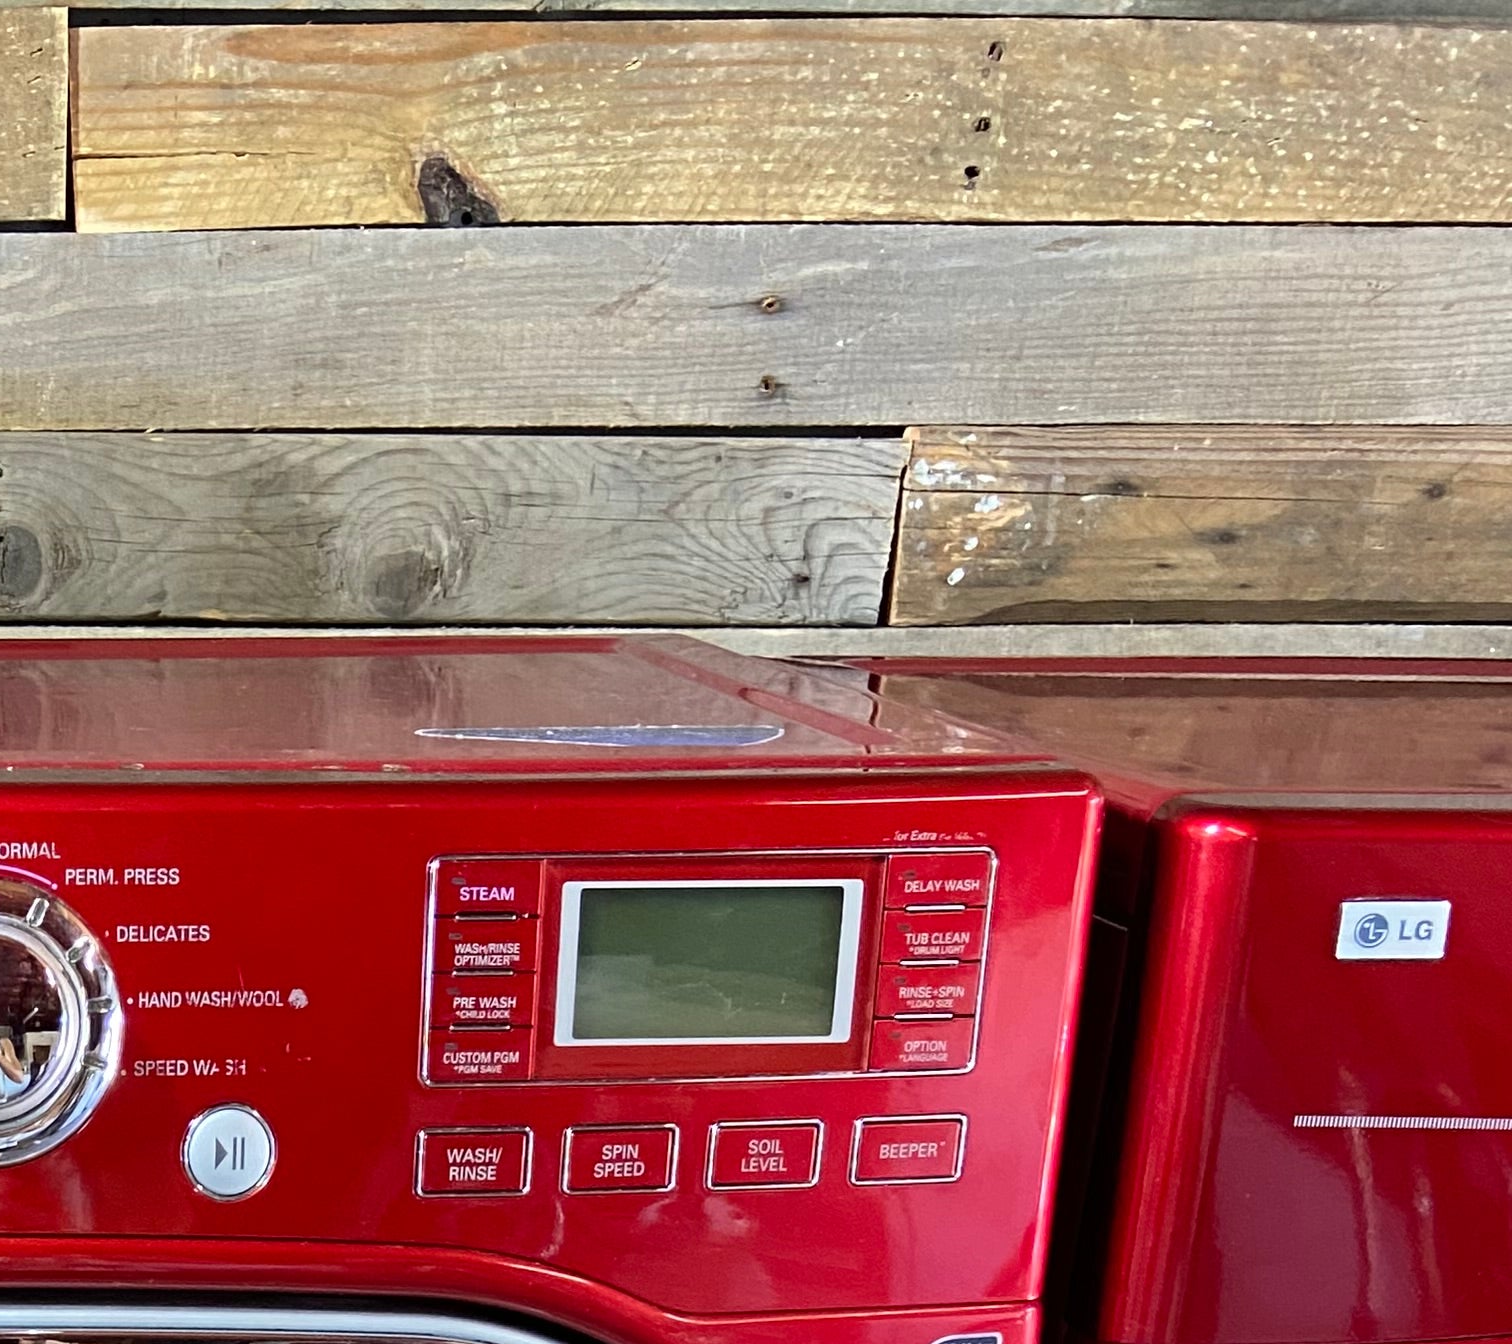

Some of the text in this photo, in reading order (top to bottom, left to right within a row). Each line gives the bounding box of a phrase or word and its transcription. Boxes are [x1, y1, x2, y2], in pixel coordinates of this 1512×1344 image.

[910, 830, 938, 841] Extra
[64, 867, 181, 886] PERM. PRESS
[459, 886, 515, 901] STEAM
[904, 879, 981, 893] DELAY WASH
[116, 925, 211, 943] DELICATES
[1398, 919, 1435, 941] LG
[904, 932, 971, 945] TUB CLEAN
[454, 943, 521, 955] WASH/RINSE
[940, 945, 965, 954] LIGHT
[138, 990, 285, 1009] HAND WASH/WOOL
[452, 996, 518, 1009] PRE WASH
[935, 999, 955, 1008] SIZE
[488, 1009, 511, 1019] LOCK
[903, 1041, 948, 1052] OPTION
[443, 1051, 520, 1065] CUSTOM PGM
[134, 1060, 189, 1077] SPEED
[479, 1064, 503, 1074] SAVE
[602, 1144, 640, 1160] SPIN
[748, 1140, 784, 1155] SOIL
[879, 1143, 938, 1160] BEEPER
[446, 1147, 503, 1164] WASH/
[593, 1162, 645, 1179] SPEED
[740, 1157, 788, 1173] LEVEL
[449, 1166, 497, 1181] RINSE
